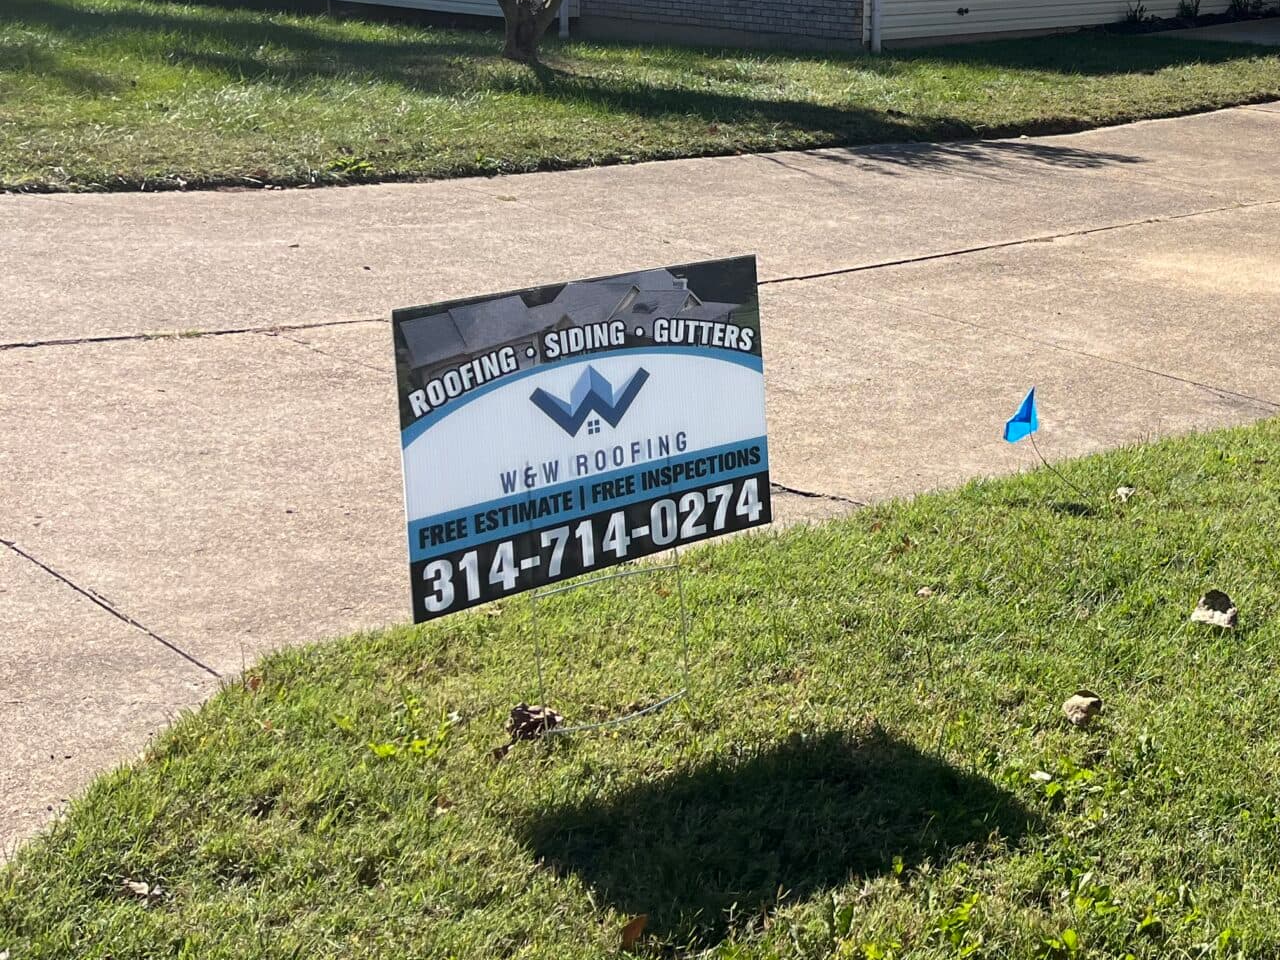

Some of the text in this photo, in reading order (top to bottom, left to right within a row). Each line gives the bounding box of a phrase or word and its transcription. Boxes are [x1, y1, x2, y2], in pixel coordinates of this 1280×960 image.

[409, 319, 755, 418] ROOFING SIDING GUTTERS
[418, 446, 761, 549] FREE ESTIMATE FREE INSPECTIONS
[577, 431, 688, 476] ROOFING
[422, 478, 763, 614] 314-714-0274
